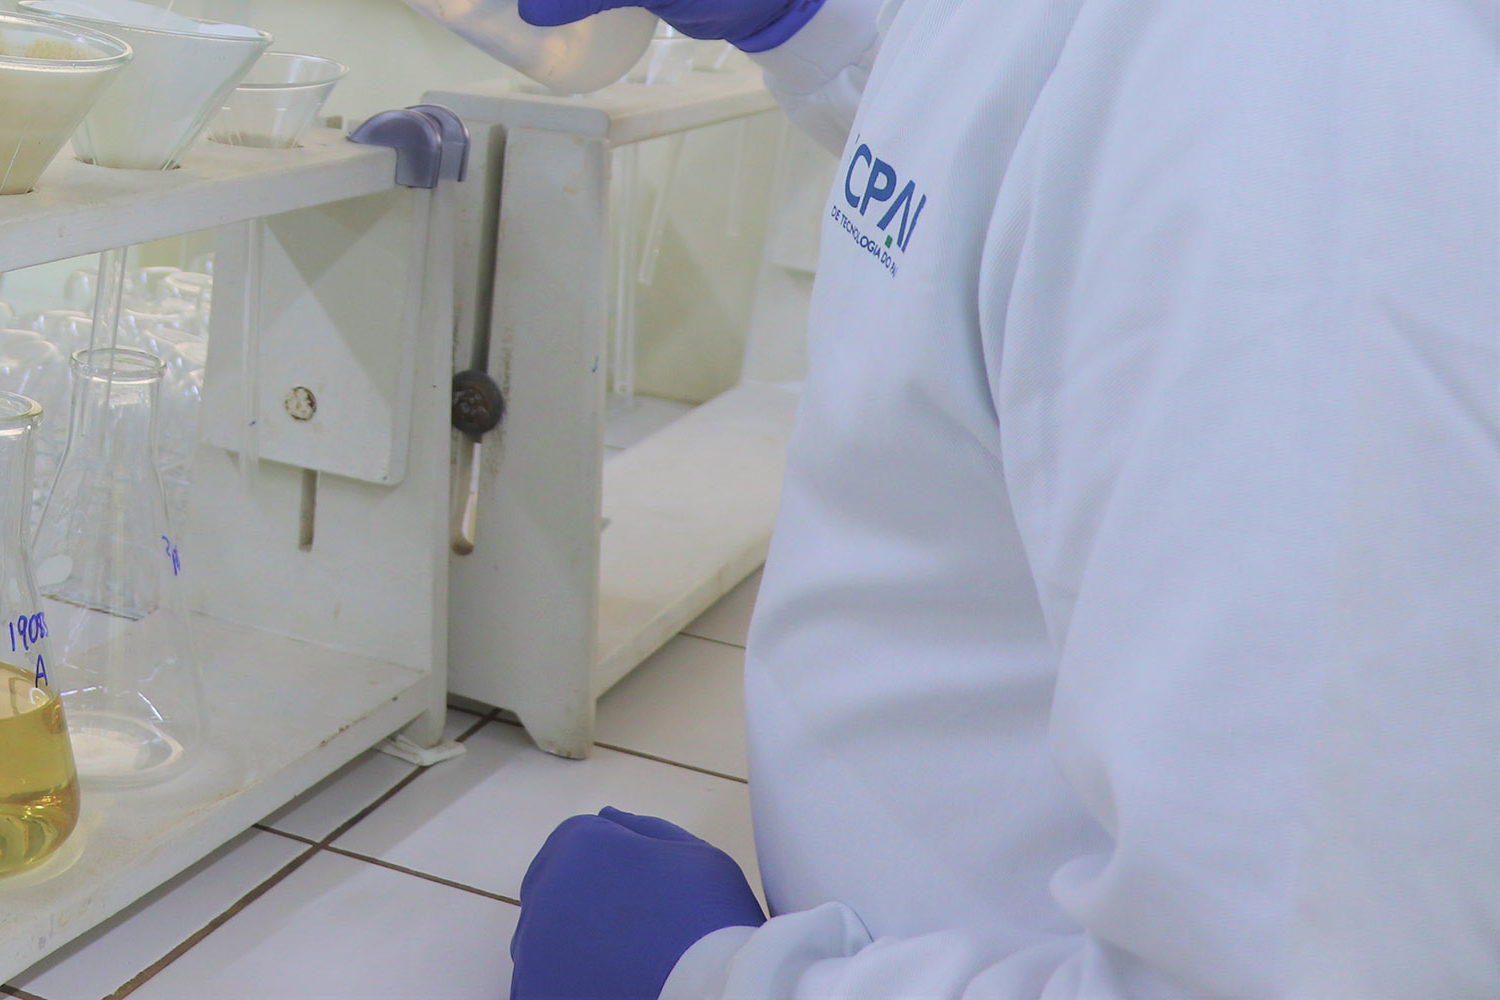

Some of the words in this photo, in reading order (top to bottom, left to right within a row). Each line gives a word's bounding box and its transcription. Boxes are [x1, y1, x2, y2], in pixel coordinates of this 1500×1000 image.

[830, 205, 841, 222] DE
[840, 213, 882, 260] TECNOLOGIA
[880, 250, 892, 269] DO
[35, 653, 49, 689] A
